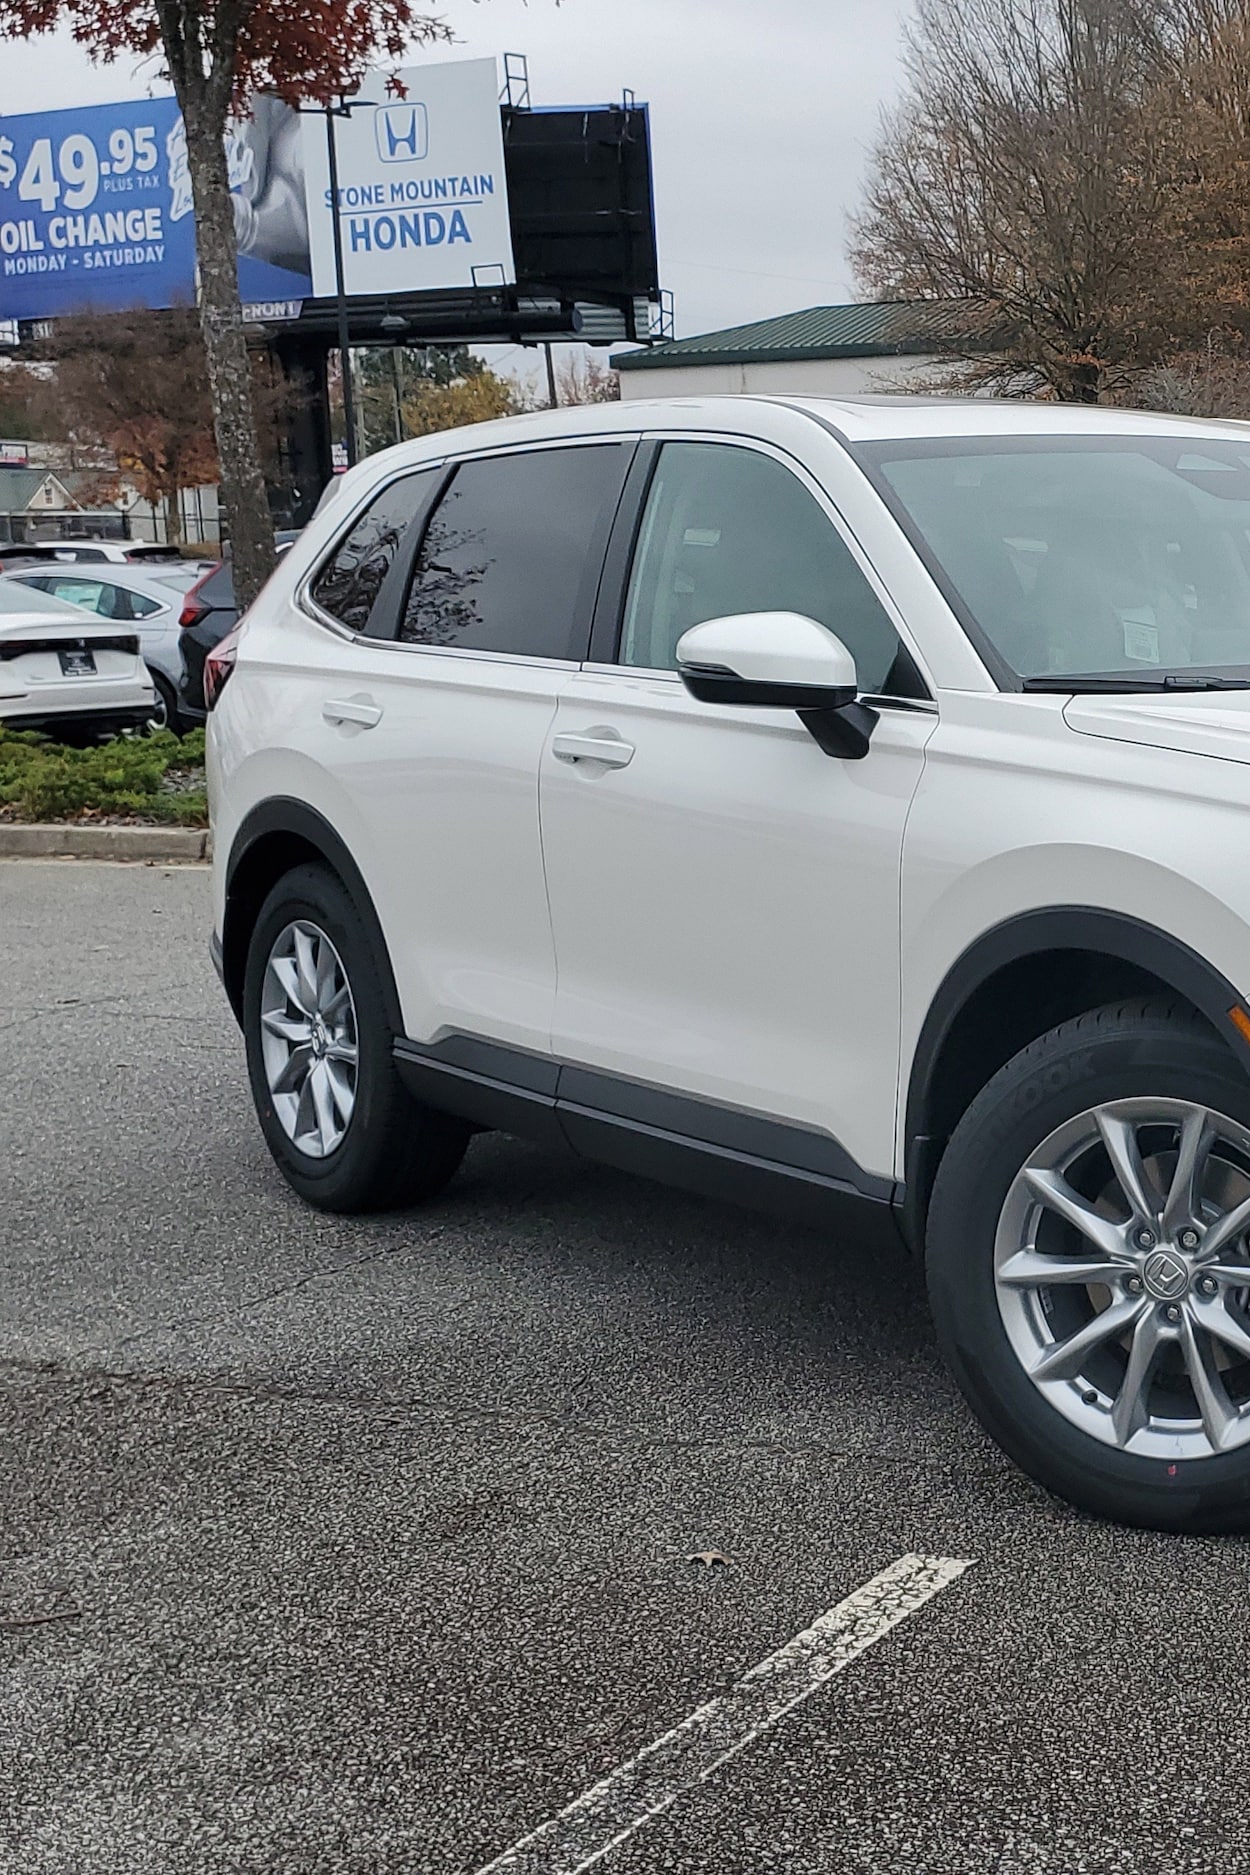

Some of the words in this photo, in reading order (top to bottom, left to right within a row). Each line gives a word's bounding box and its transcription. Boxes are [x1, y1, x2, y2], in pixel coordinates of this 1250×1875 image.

[0, 126, 158, 212] $49.95
[103, 177, 133, 192] PLUS
[137, 175, 160, 189] TAX
[325, 184, 384, 209] STONE
[390, 174, 494, 201] MOUNTAIN
[0, 220, 45, 254] OIL
[48, 207, 163, 249] CHANGE
[350, 209, 473, 252] HONDA
[4, 253, 66, 276] MONDAY
[84, 245, 165, 268] SATURDAY
